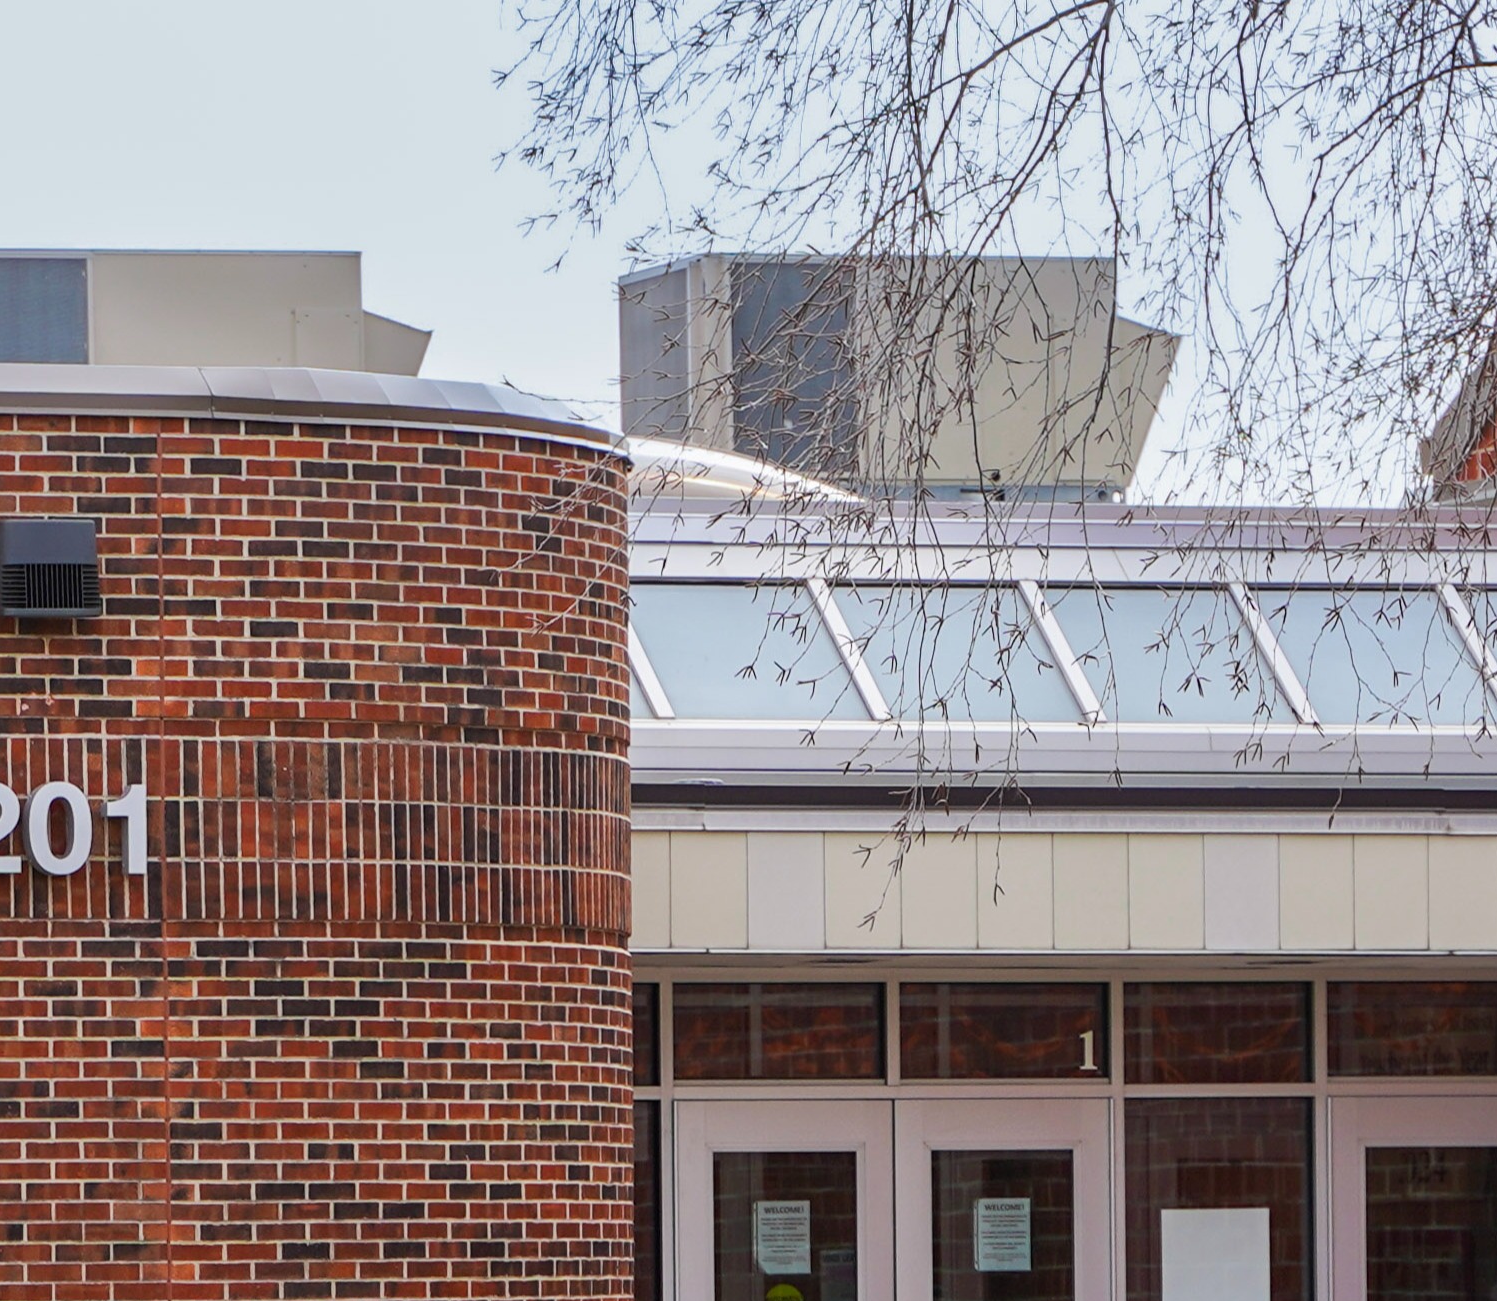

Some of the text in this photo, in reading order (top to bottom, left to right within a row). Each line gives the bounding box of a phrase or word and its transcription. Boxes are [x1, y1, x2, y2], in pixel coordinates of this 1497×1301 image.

[1078, 1029, 1098, 1071] 1
[763, 1205, 804, 1215] WELCOME!
[984, 1203, 1025, 1212] WELCOME!
